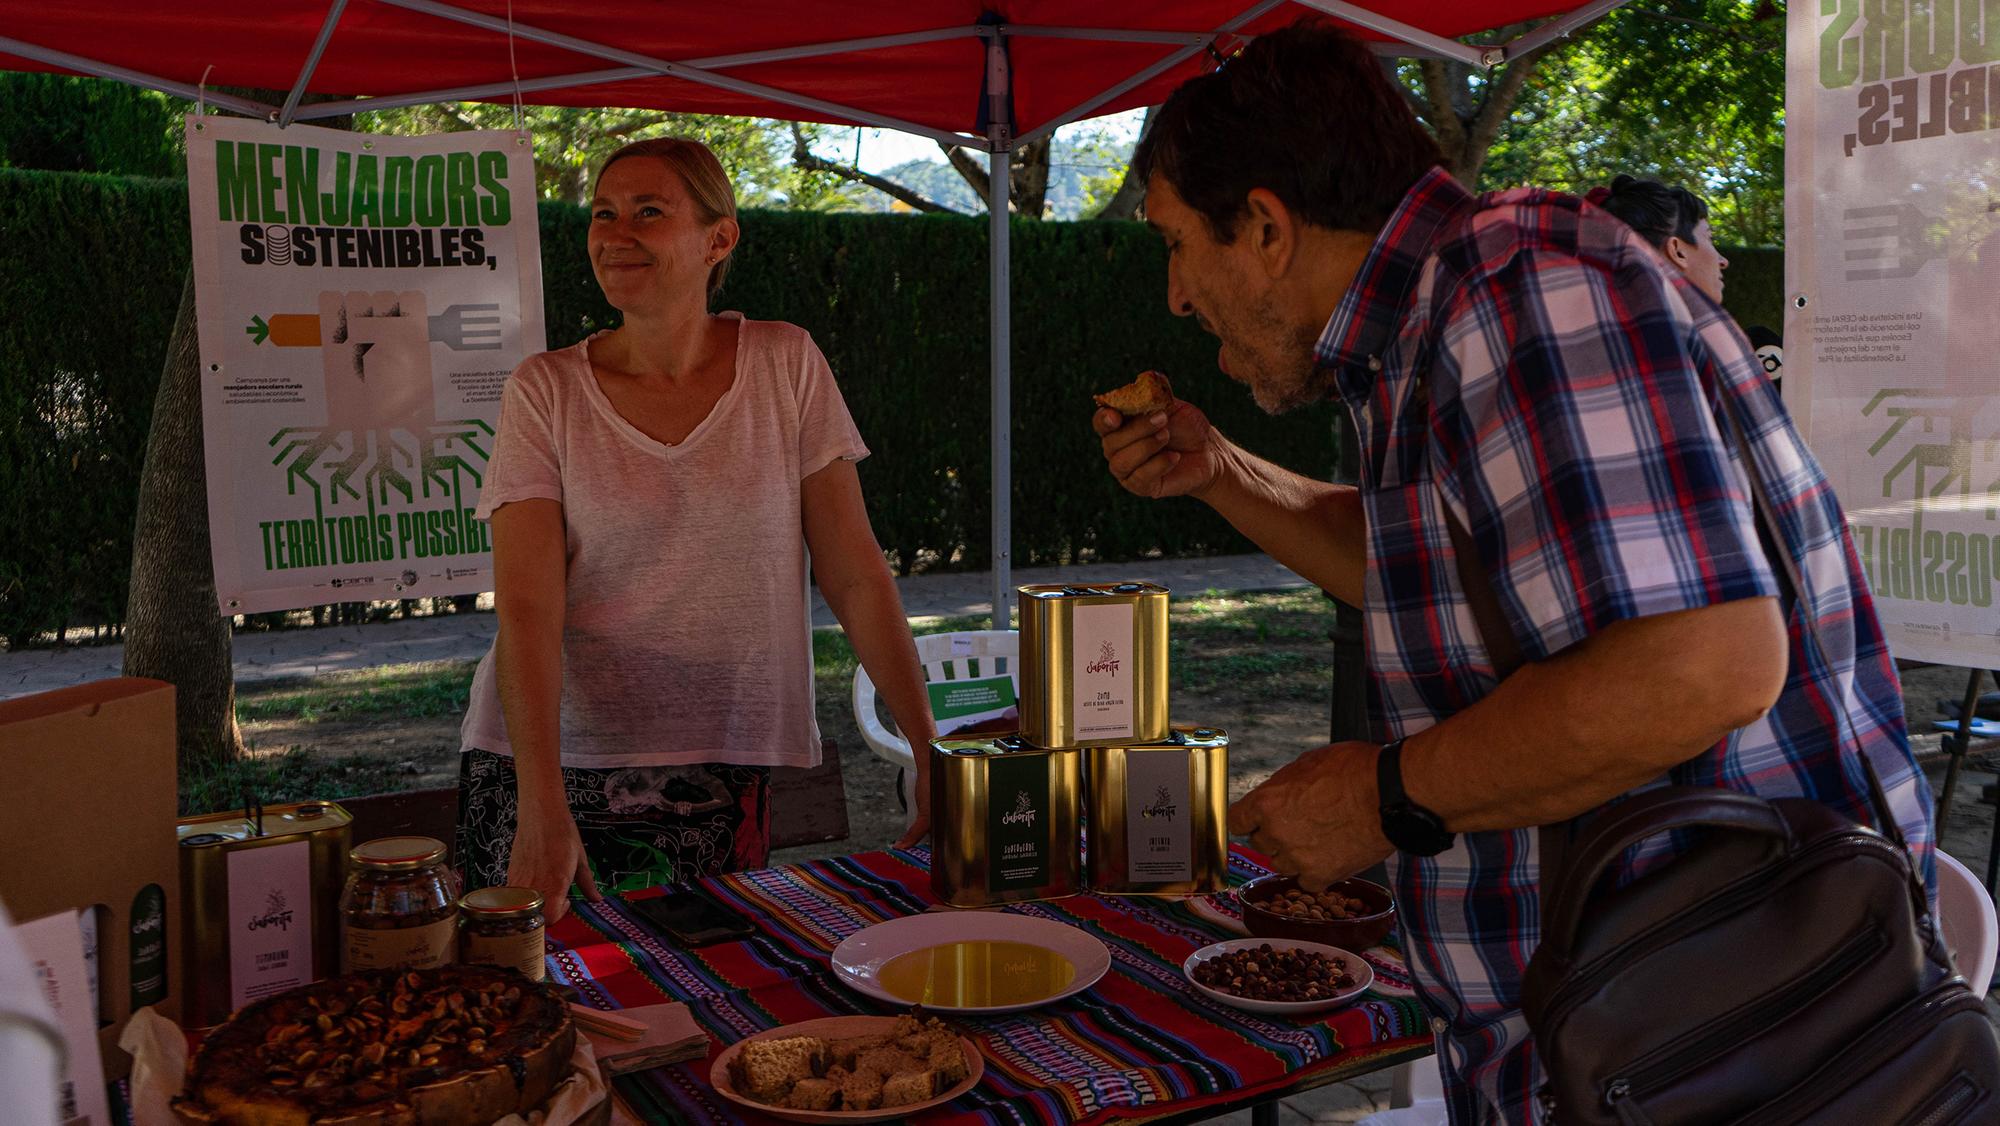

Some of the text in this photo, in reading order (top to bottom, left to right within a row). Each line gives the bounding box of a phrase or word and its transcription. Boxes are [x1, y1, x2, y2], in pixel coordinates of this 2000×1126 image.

[216, 140, 511, 227] MENJADORS
[259, 506, 491, 571] TERRITORIS POSSIBL
[1086, 660, 1120, 678] Saborita
[1002, 810, 1036, 828] Saborita
